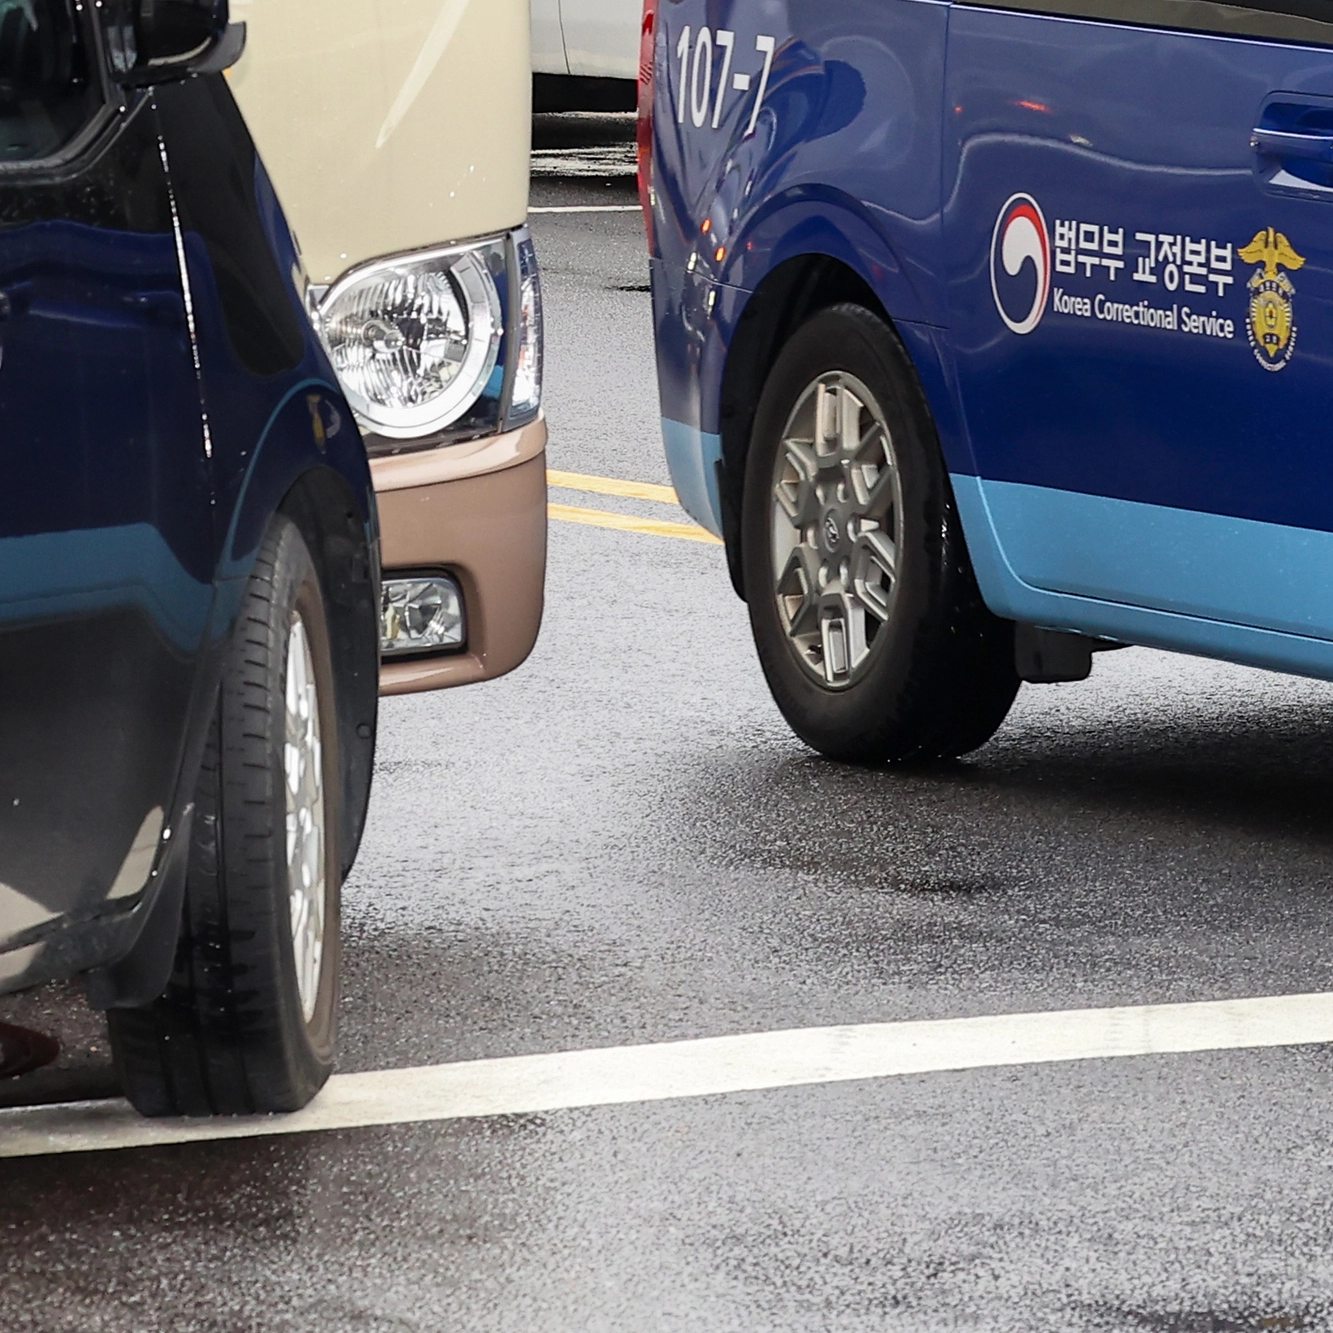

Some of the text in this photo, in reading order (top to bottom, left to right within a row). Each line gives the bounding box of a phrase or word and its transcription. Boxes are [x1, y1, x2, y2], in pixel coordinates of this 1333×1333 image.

[677, 25, 775, 140] 107-7
[1055, 219, 1234, 297] 법무부 교정본부
[1053, 287, 1235, 339] Korea Correctional Service
